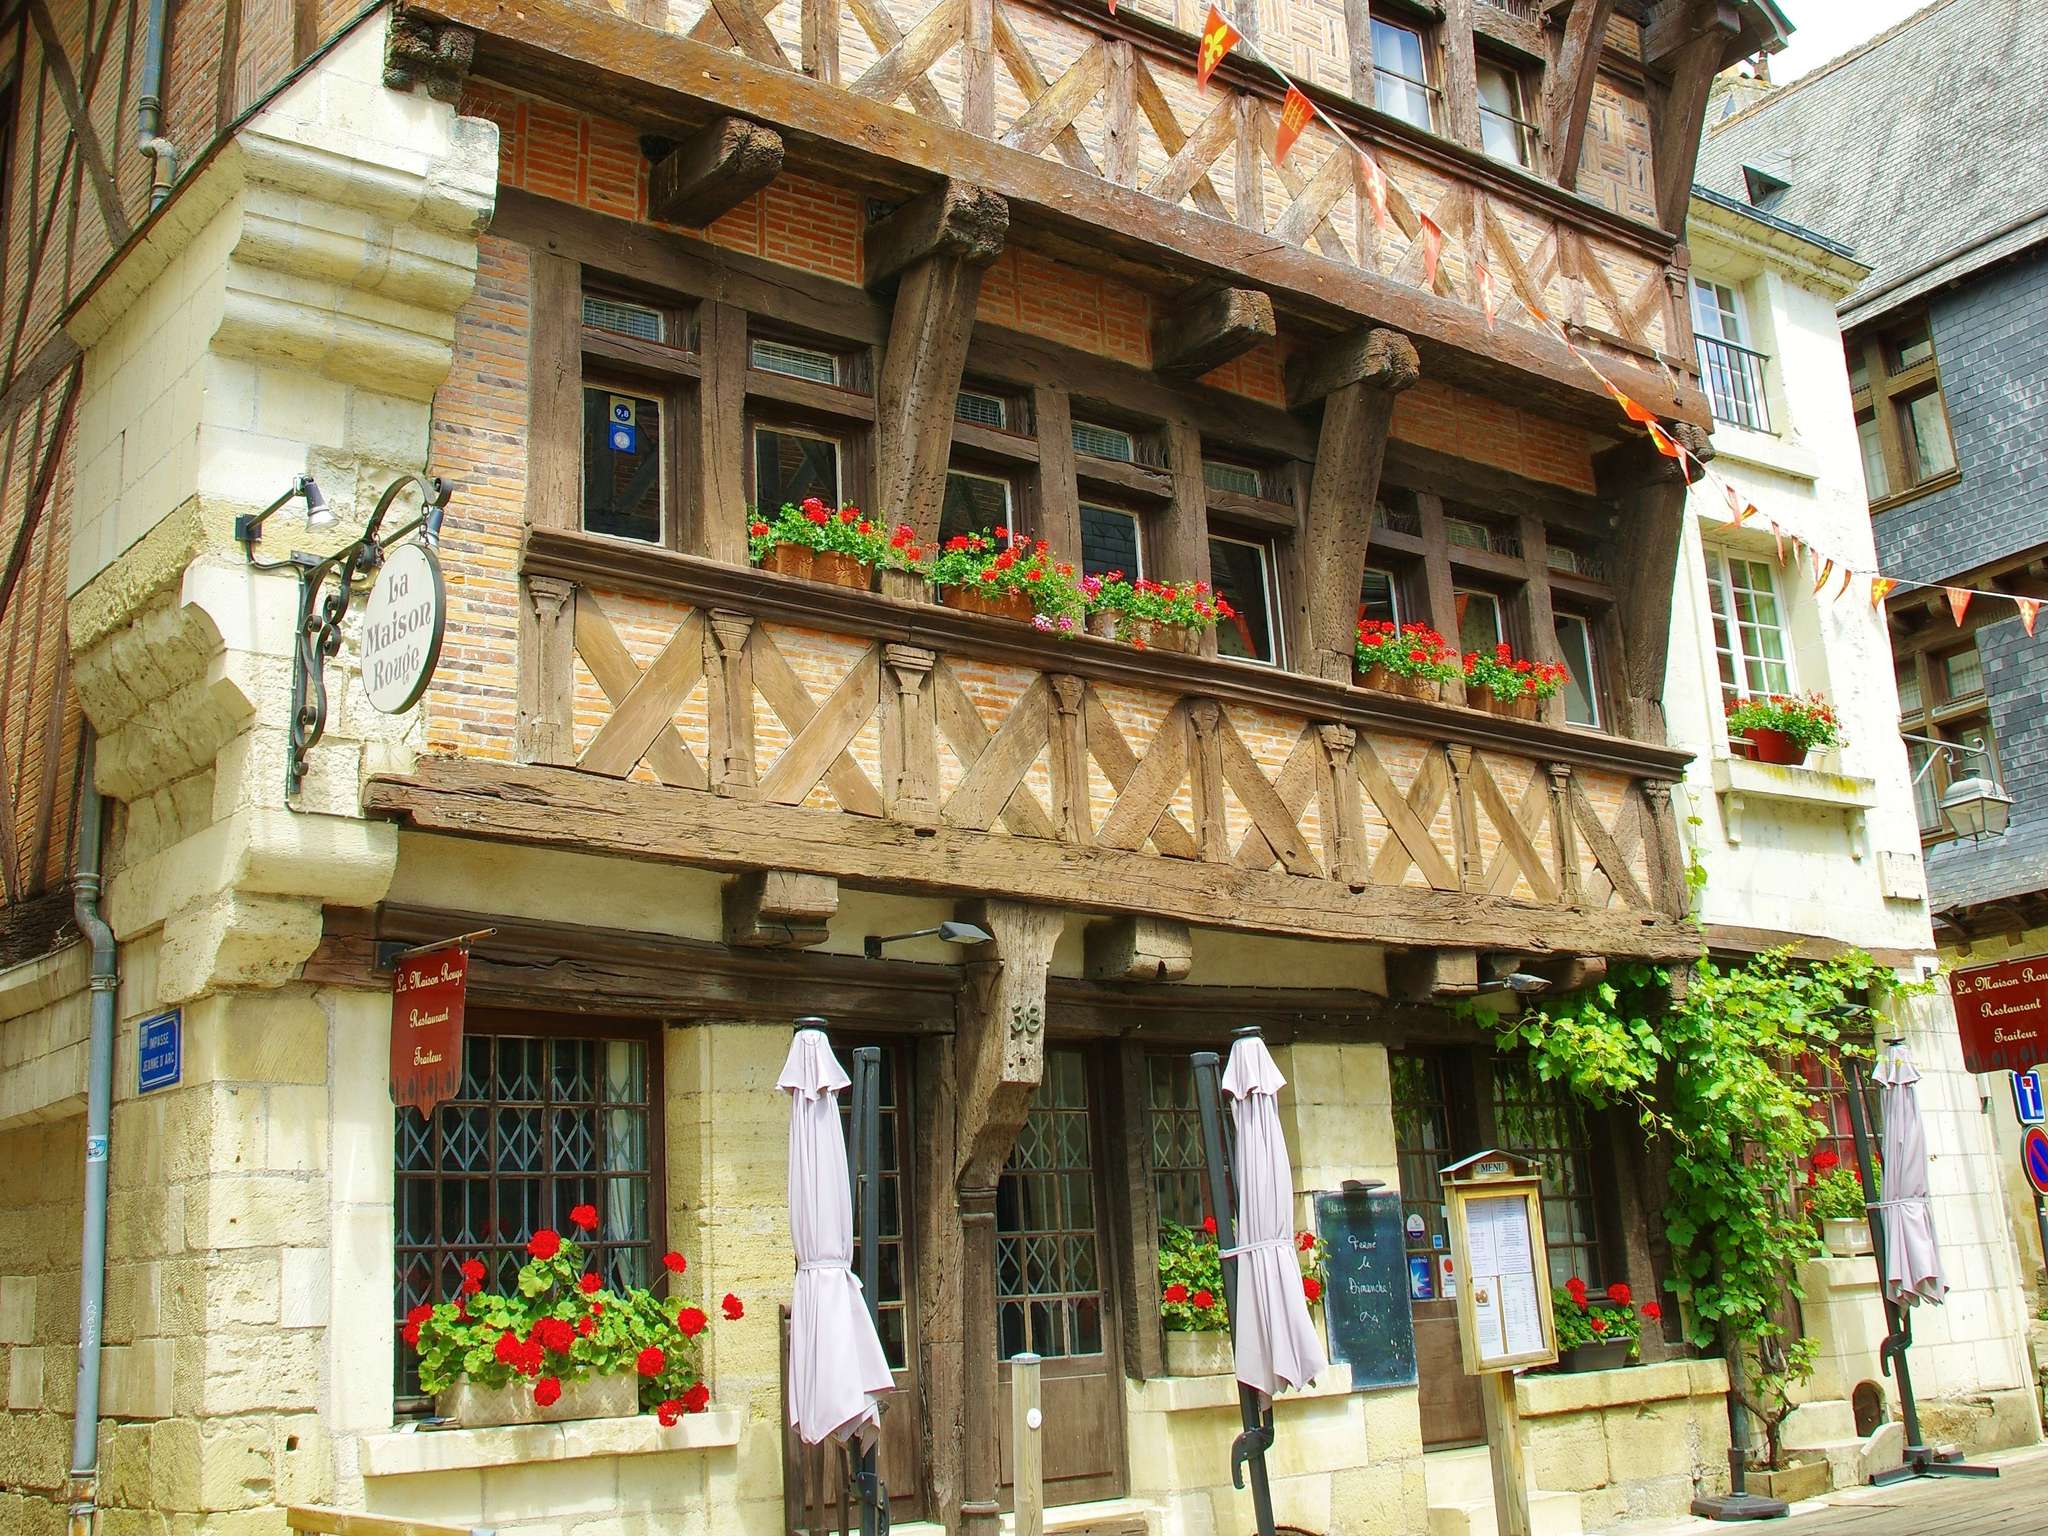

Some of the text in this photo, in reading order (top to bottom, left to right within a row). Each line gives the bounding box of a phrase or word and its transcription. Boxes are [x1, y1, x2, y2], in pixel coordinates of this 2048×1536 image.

[388, 572, 408, 604] La
[365, 601, 431, 658] Maison
[374, 645, 420, 692] Rouge
[396, 962, 463, 992] La Maison Rouge
[1956, 979, 1972, 995] La
[1974, 976, 2020, 991] Maison
[410, 1007, 449, 1028] Restaurant
[1010, 1000, 1041, 1033] 38
[1980, 997, 2041, 1018] Restaurant
[148, 1031, 169, 1050] IMPASSE
[1994, 1027, 2038, 1043] Traiteur
[413, 1046, 442, 1066] Traiteur
[1480, 1162, 1504, 1172] MENU
